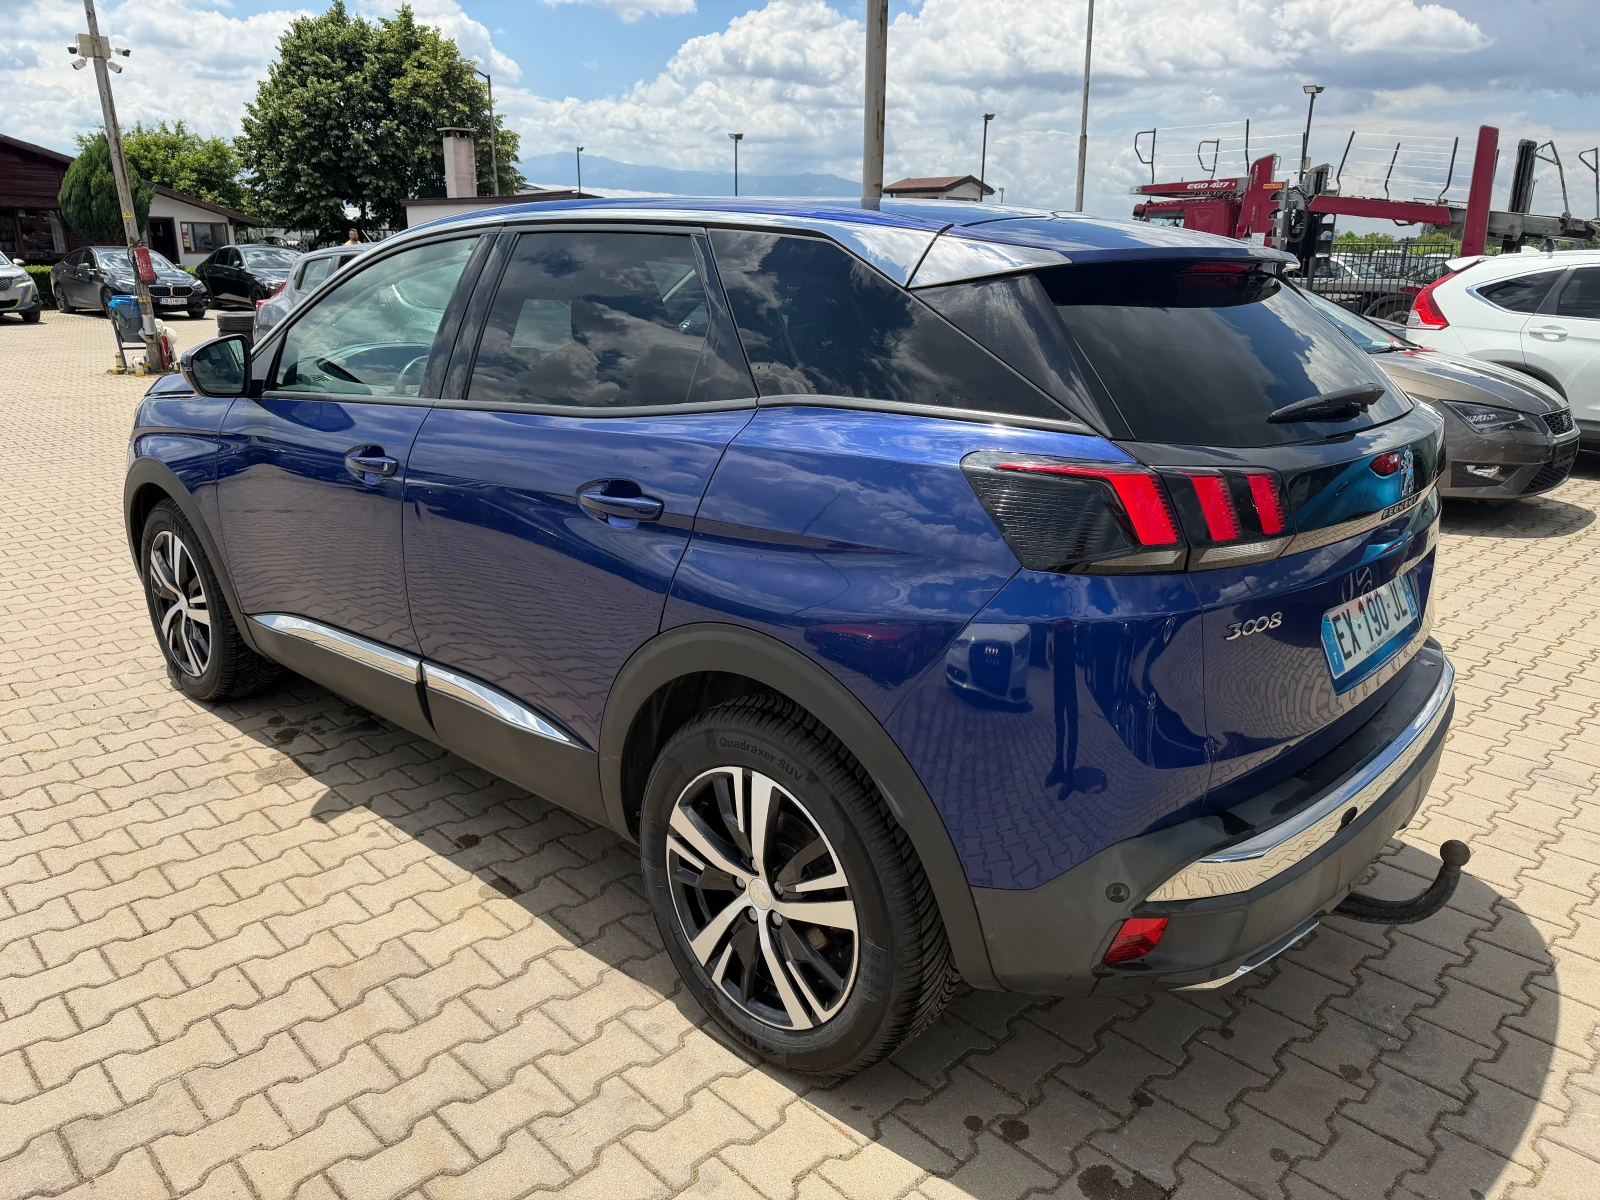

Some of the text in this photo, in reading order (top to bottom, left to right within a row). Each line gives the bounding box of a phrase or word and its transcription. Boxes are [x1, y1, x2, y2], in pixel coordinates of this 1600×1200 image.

[1187, 181, 1230, 190] EGO 427
[1382, 494, 1419, 519] PEUGEOT
[1224, 611, 1283, 640] 3008
[719, 736, 806, 782] Quadraxer SUV
